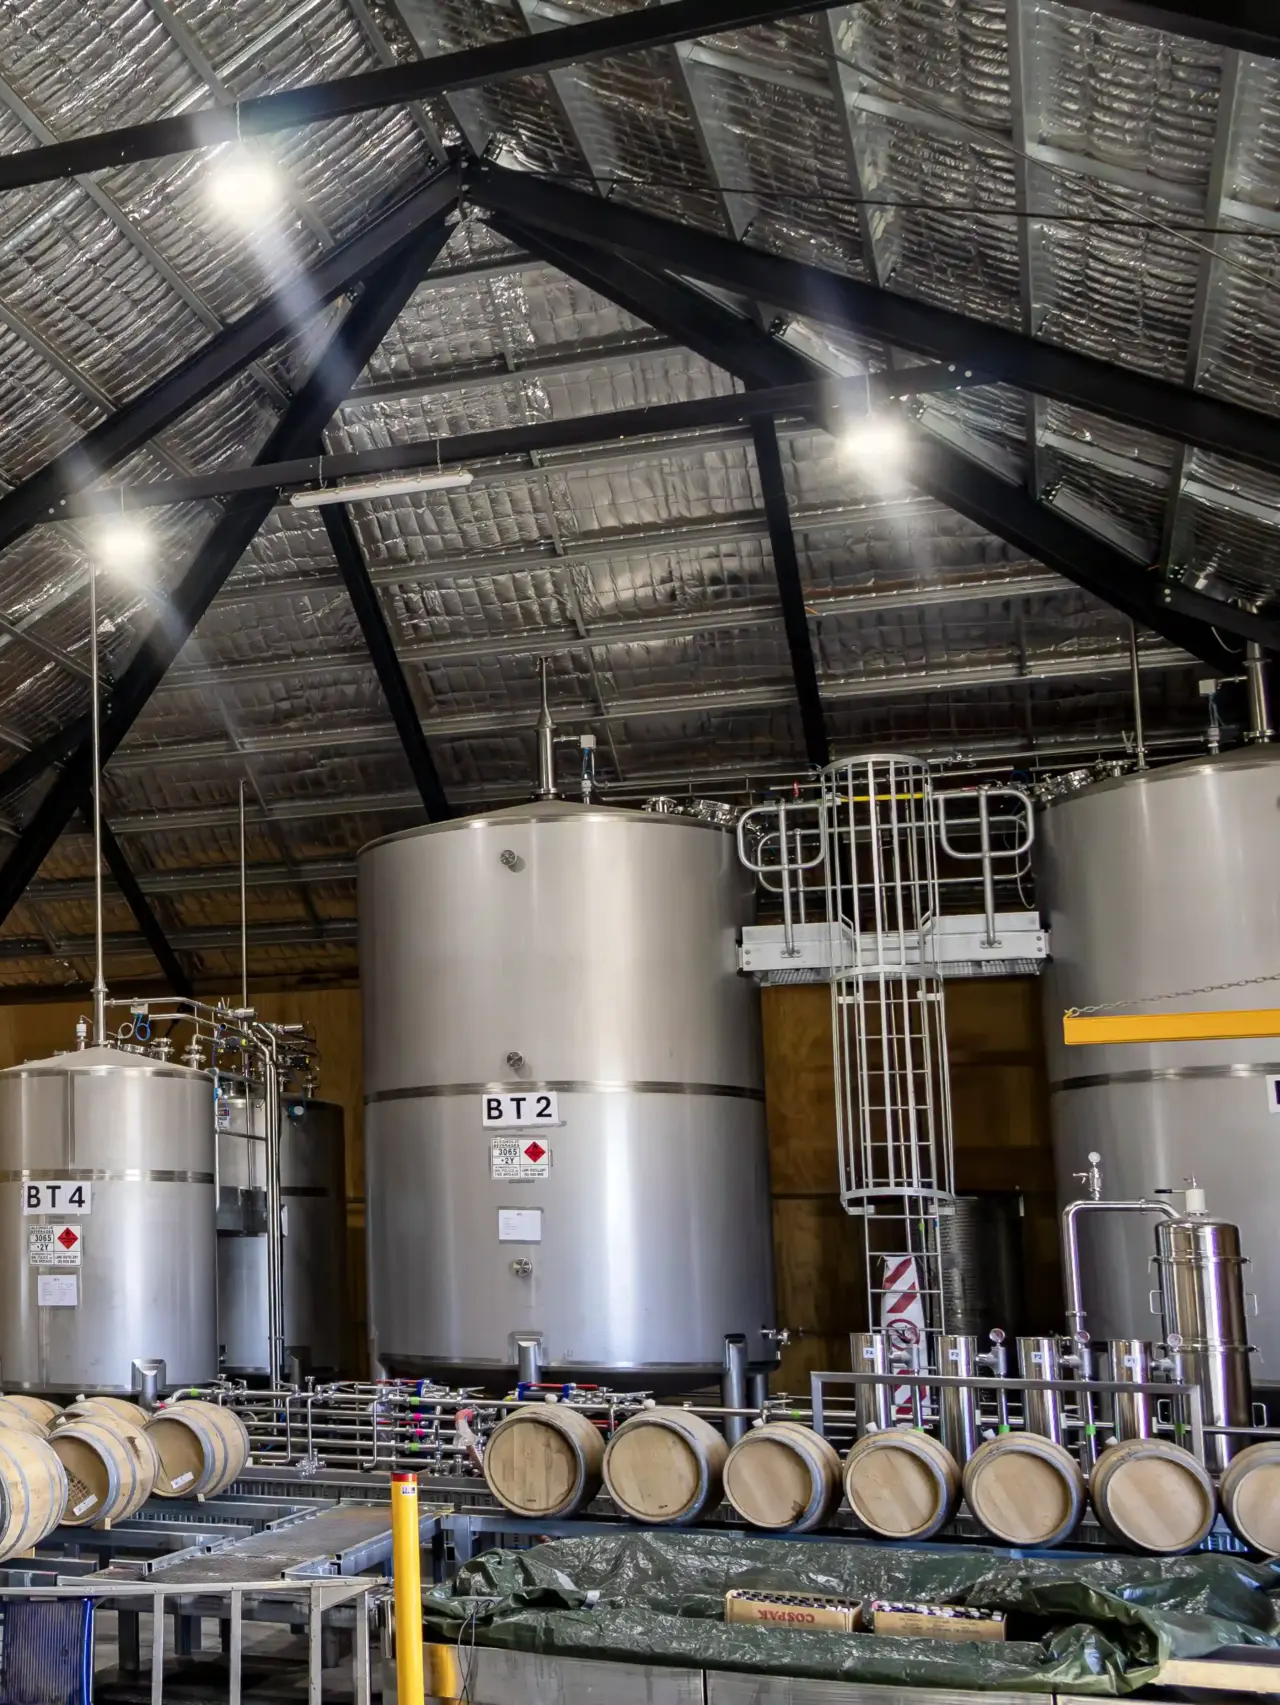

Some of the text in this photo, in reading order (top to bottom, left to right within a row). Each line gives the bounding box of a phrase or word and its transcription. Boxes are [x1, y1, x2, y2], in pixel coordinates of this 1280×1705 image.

[486, 1096, 552, 1120] BT2
[498, 1148, 518, 1156] 3065
[27, 1185, 86, 1208] BT4
[34, 1234, 52, 1242] 3065
[757, 1610, 815, 1624] COSPAK
